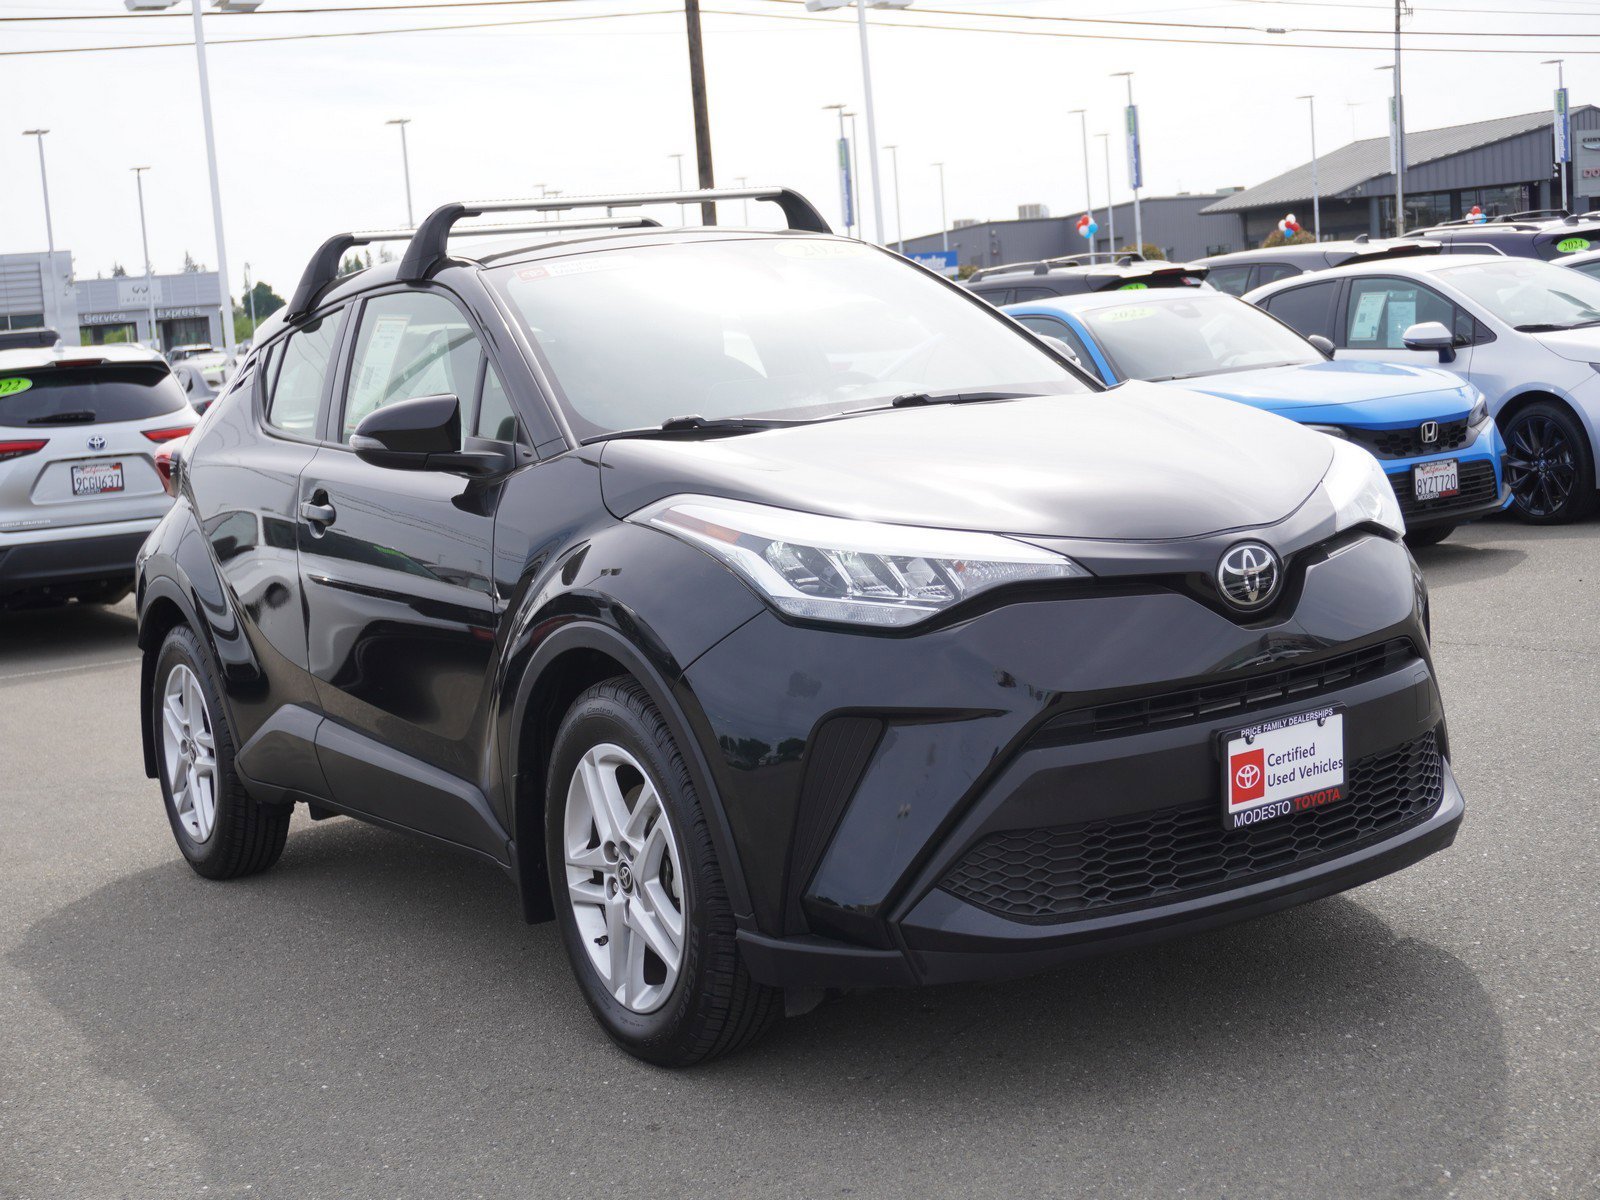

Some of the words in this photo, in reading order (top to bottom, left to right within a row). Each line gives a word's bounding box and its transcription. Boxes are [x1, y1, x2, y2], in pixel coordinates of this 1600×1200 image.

[1563, 240, 1584, 251] 2024
[84, 313, 126, 324] Service
[157, 308, 201, 320] Express
[76, 474, 120, 492] 9CGU637
[1417, 473, 1457, 496] 8YZT720
[1240, 726, 1262, 738] PRICE
[1263, 719, 1288, 732] FAMILY
[1288, 708, 1333, 726] DEALERSHIPS
[1267, 742, 1316, 767] Certified
[1267, 767, 1296, 787] Used
[1298, 757, 1343, 779] Vehicles
[1233, 800, 1291, 828] MODESTO
[1293, 787, 1341, 811] TOYOTA
